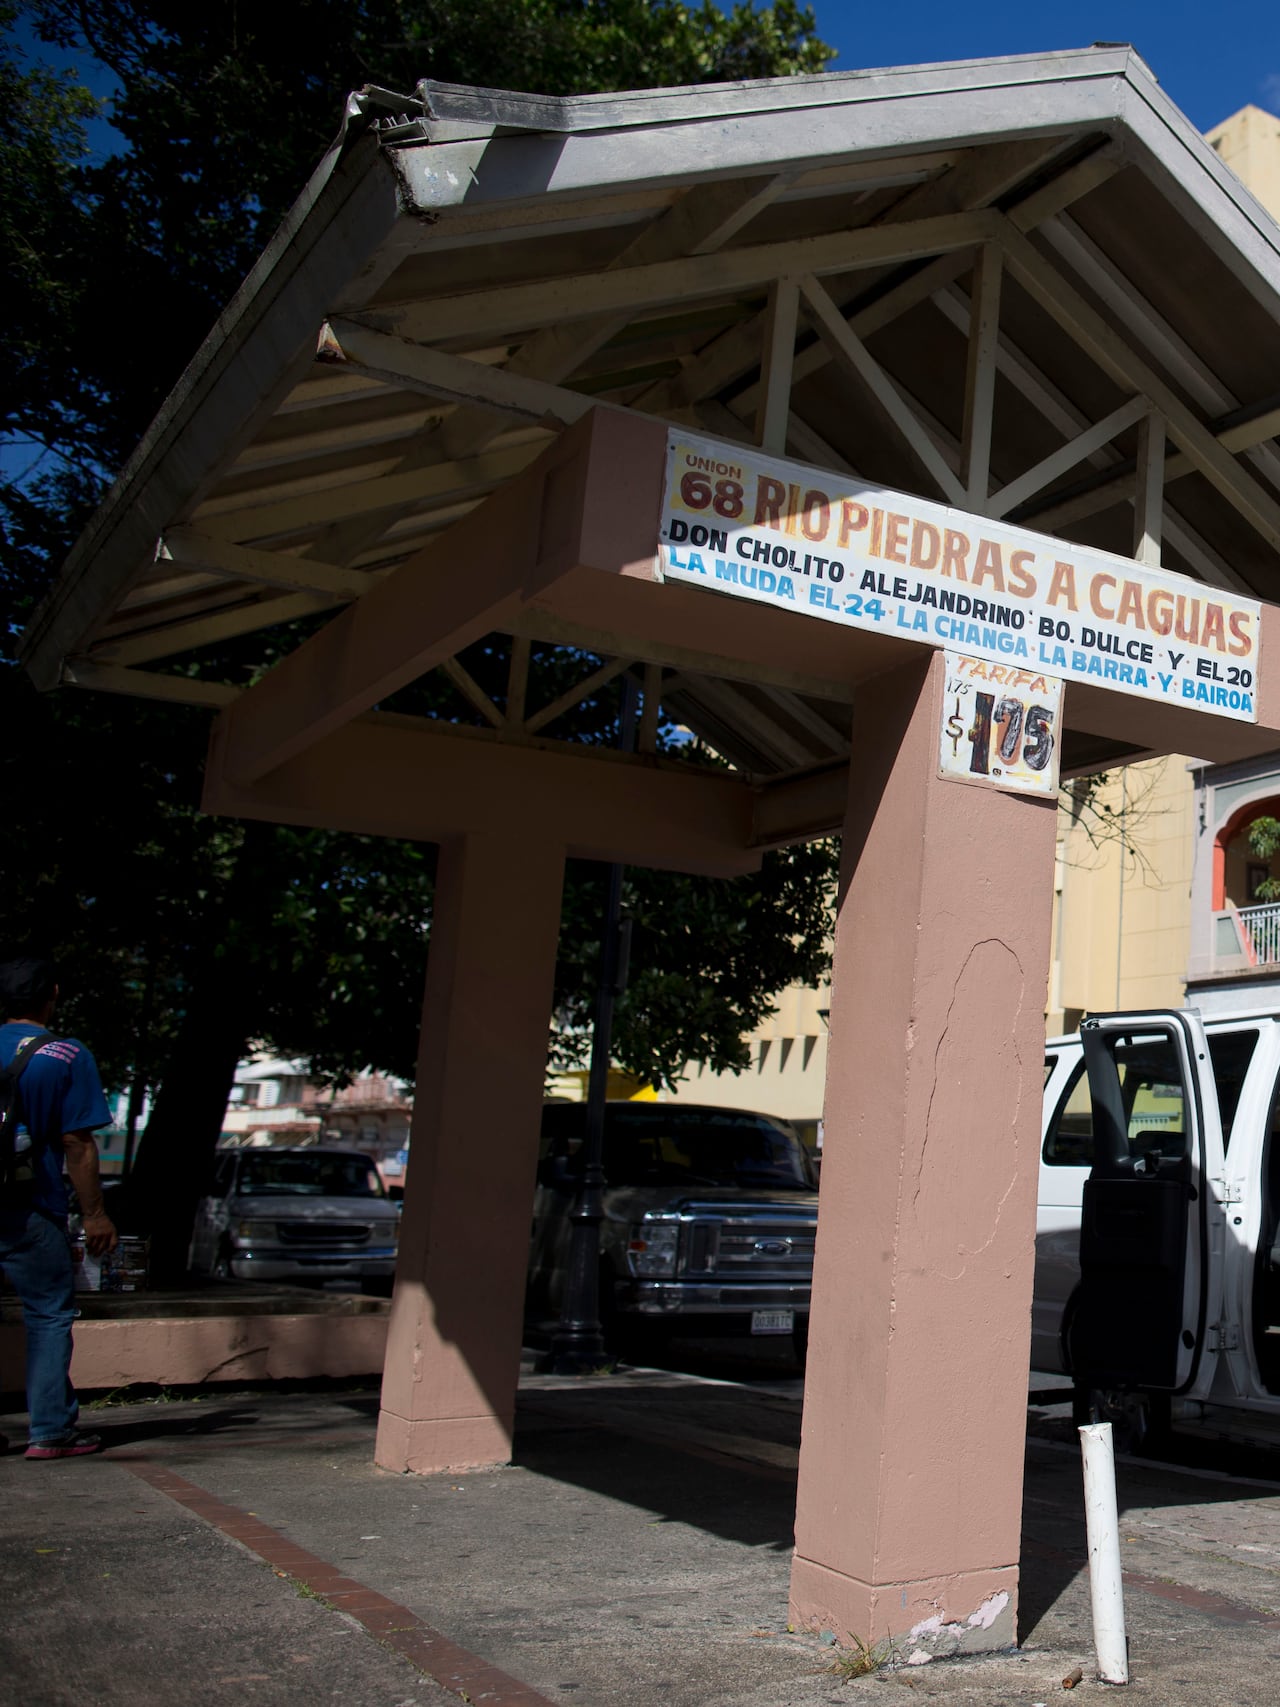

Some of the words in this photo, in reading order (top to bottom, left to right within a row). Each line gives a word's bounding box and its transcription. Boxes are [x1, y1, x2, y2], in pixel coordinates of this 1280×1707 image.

[680, 471, 745, 519] 68
[685, 454, 742, 480] UNION
[669, 518, 728, 554] DON
[735, 535, 845, 583] CHOLITO
[859, 569, 1025, 630] ALEJANDRINO
[1037, 615, 1076, 645] BO.
[1080, 626, 1154, 665] DULCE
[1167, 649, 1185, 671] Y
[753, 474, 831, 543] RIO
[836, 496, 1038, 599] PIEDRAS
[1045, 559, 1080, 613] A
[1089, 572, 1253, 658] CAGUAS
[669, 545, 707, 575] LA
[714, 559, 796, 600] MUDA
[808, 583, 841, 612] EL
[843, 594, 886, 622] 24
[896, 605, 929, 633] LA
[933, 614, 1029, 658] CHANGA
[1038, 642, 1068, 668] LA
[1071, 650, 1149, 688] BARRA
[1157, 671, 1174, 693] Y
[1181, 678, 1253, 713] BAIROA
[957, 656, 1048, 695] TARIFA
